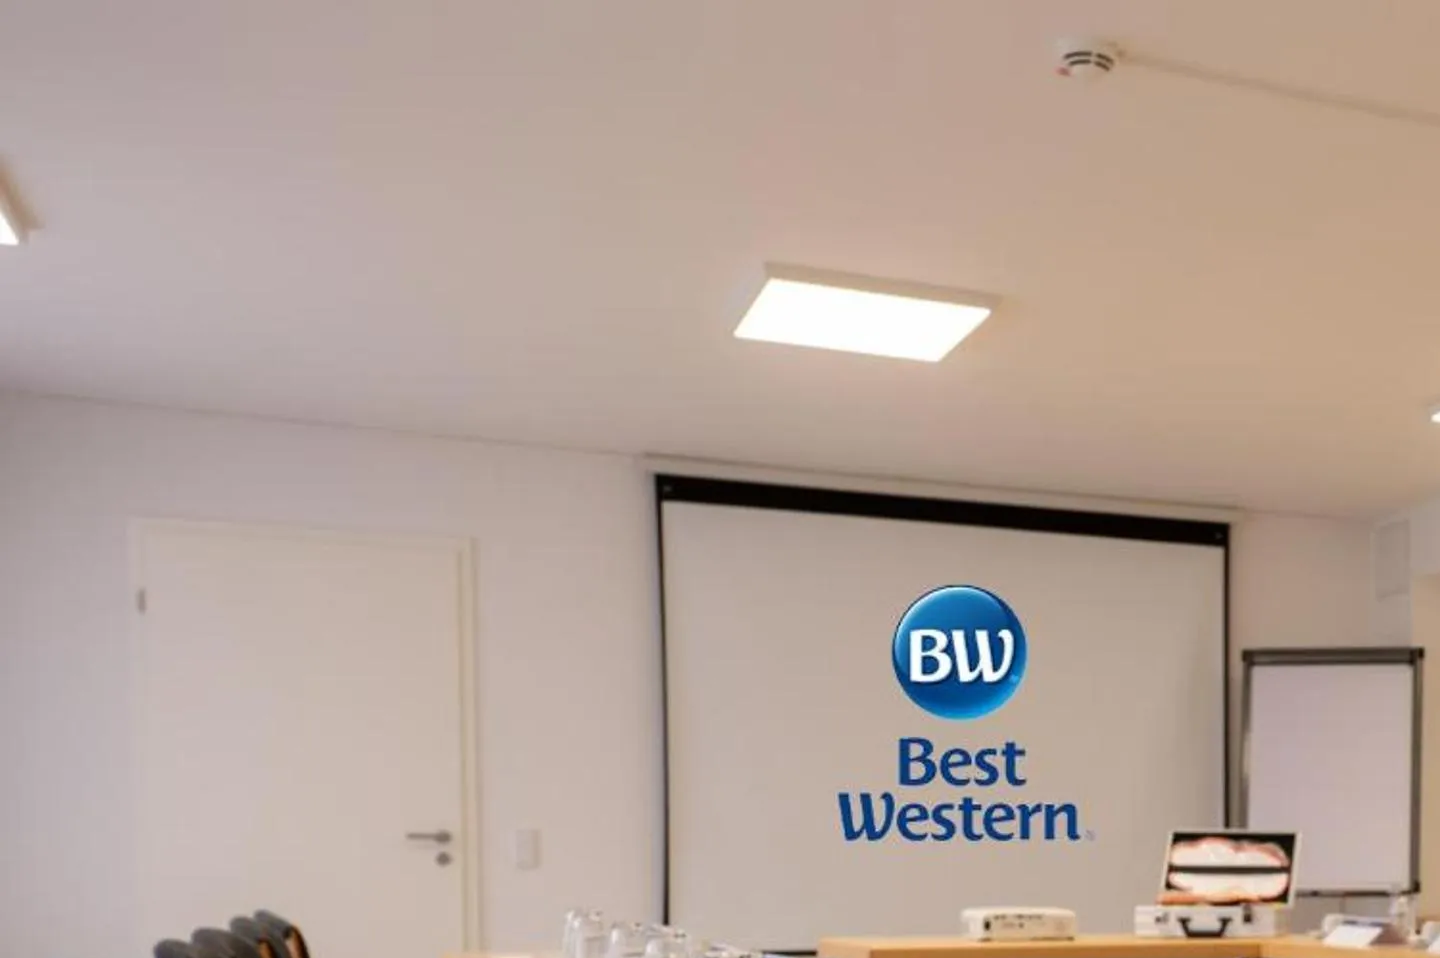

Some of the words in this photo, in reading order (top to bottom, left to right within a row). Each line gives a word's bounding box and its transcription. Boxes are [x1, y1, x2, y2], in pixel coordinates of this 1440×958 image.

[910, 628, 1015, 683] BW
[898, 737, 1027, 786] Best
[837, 792, 1081, 841] Western
